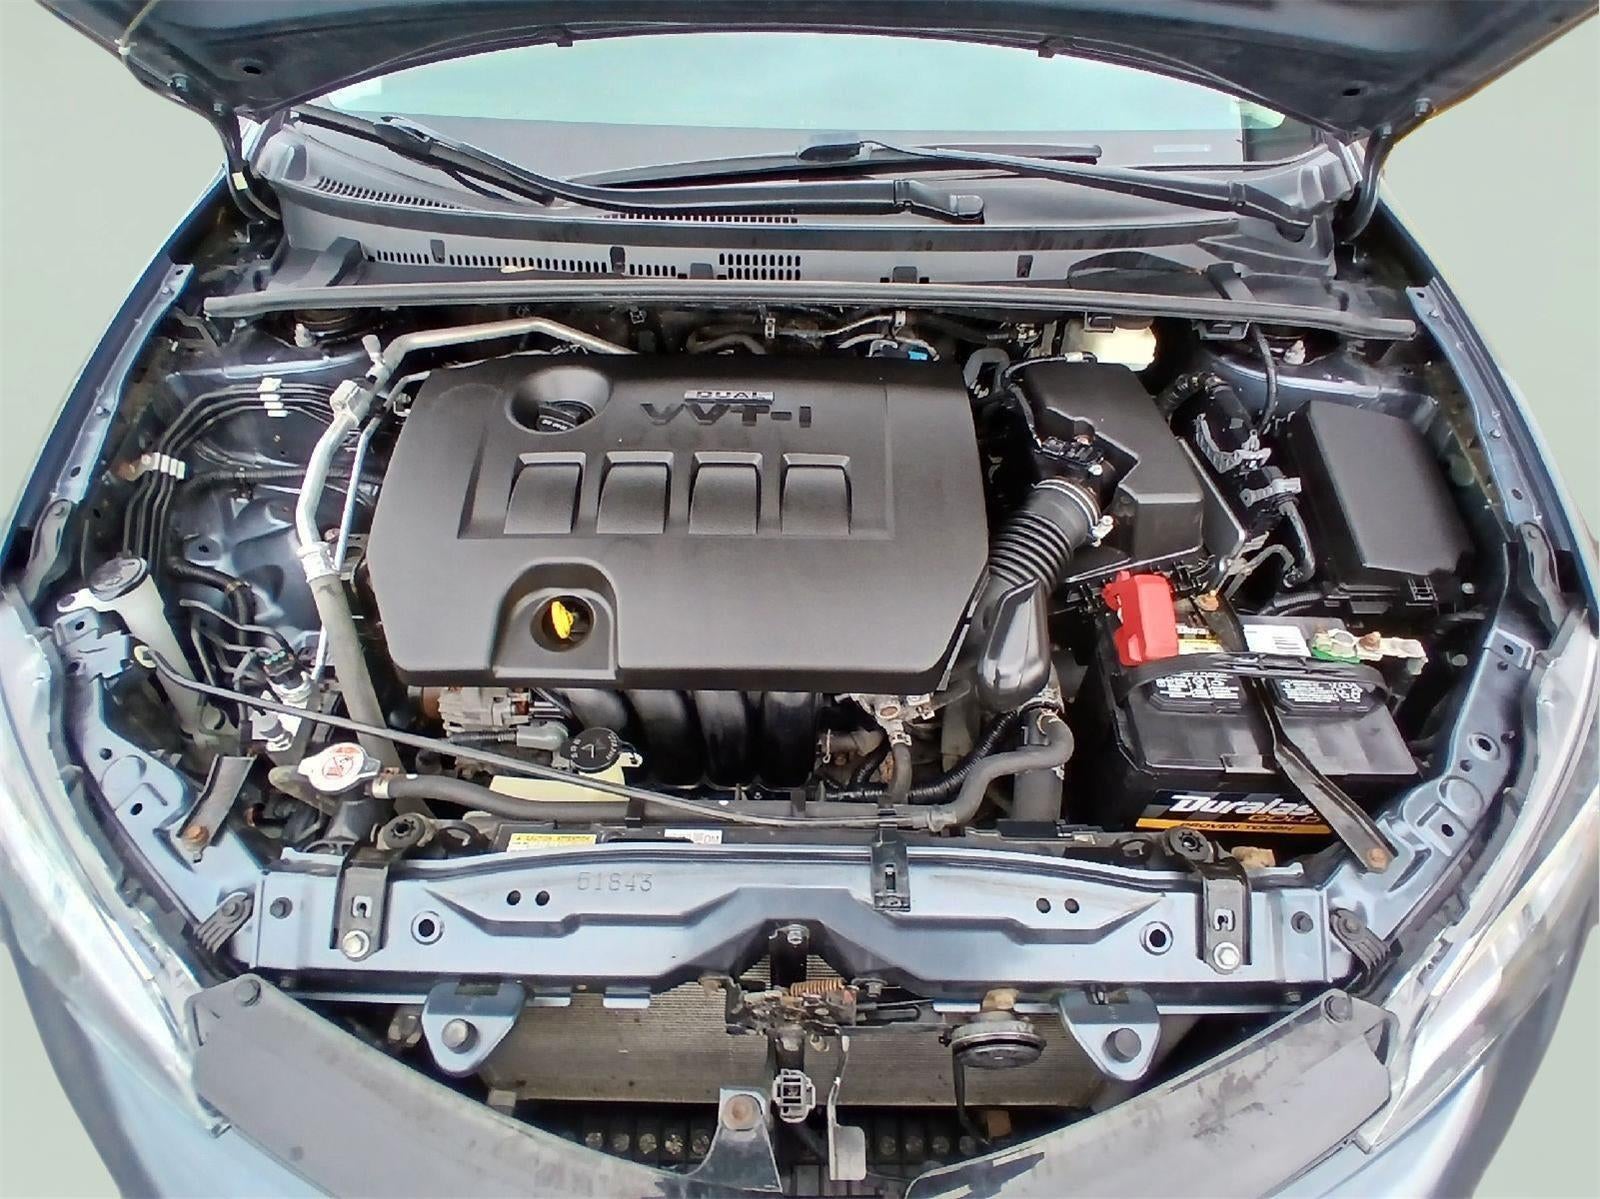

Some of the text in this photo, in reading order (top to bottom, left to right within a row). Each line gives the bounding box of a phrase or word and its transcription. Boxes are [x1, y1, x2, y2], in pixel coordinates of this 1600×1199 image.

[696, 391, 767, 400] DUAL
[1168, 794, 1318, 816] Duralas
[1248, 814, 1321, 823] GOLD
[1180, 822, 1240, 830] PROVEN
